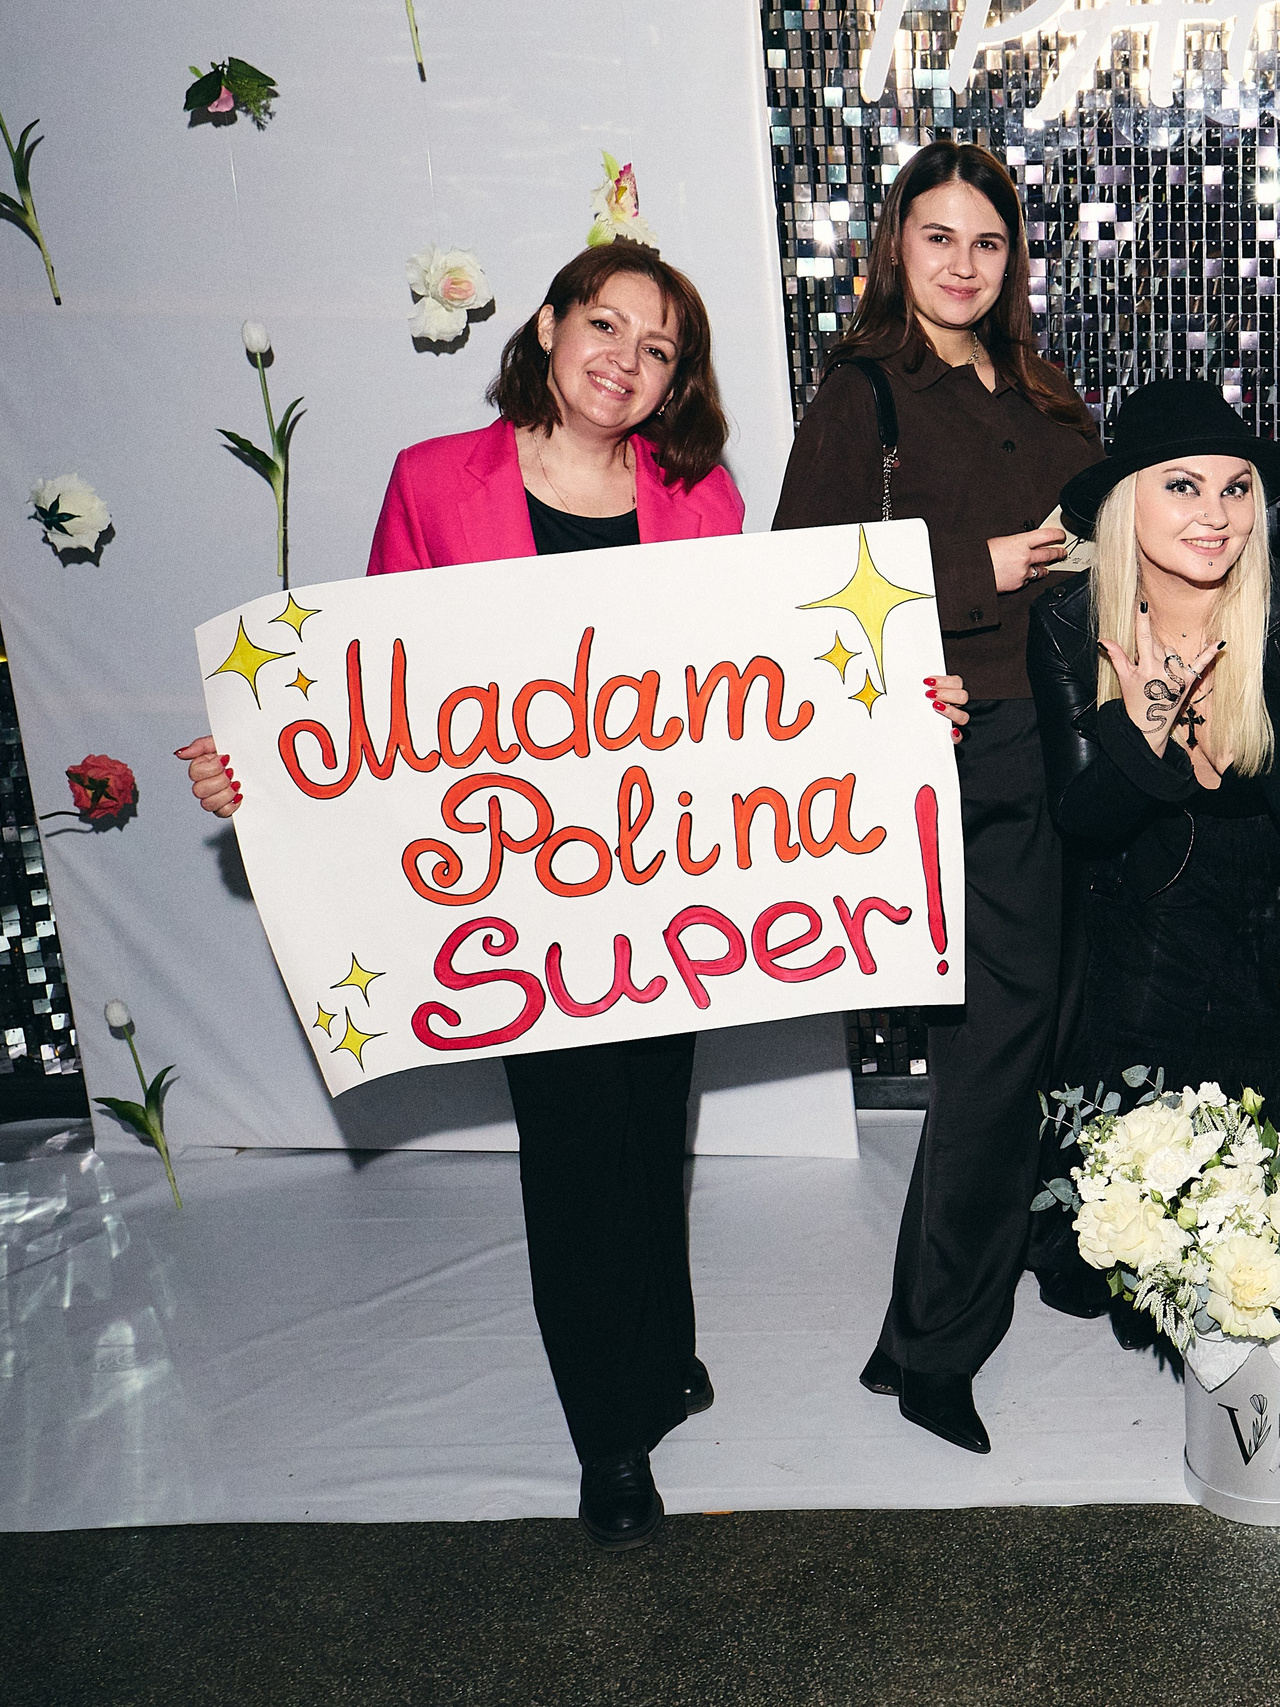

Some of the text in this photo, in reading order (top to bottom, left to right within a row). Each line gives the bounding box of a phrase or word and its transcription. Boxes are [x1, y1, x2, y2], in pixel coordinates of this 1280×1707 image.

[278, 625, 814, 800] Madam
[400, 765, 888, 907] Polina
[410, 784, 950, 1051] Super!
